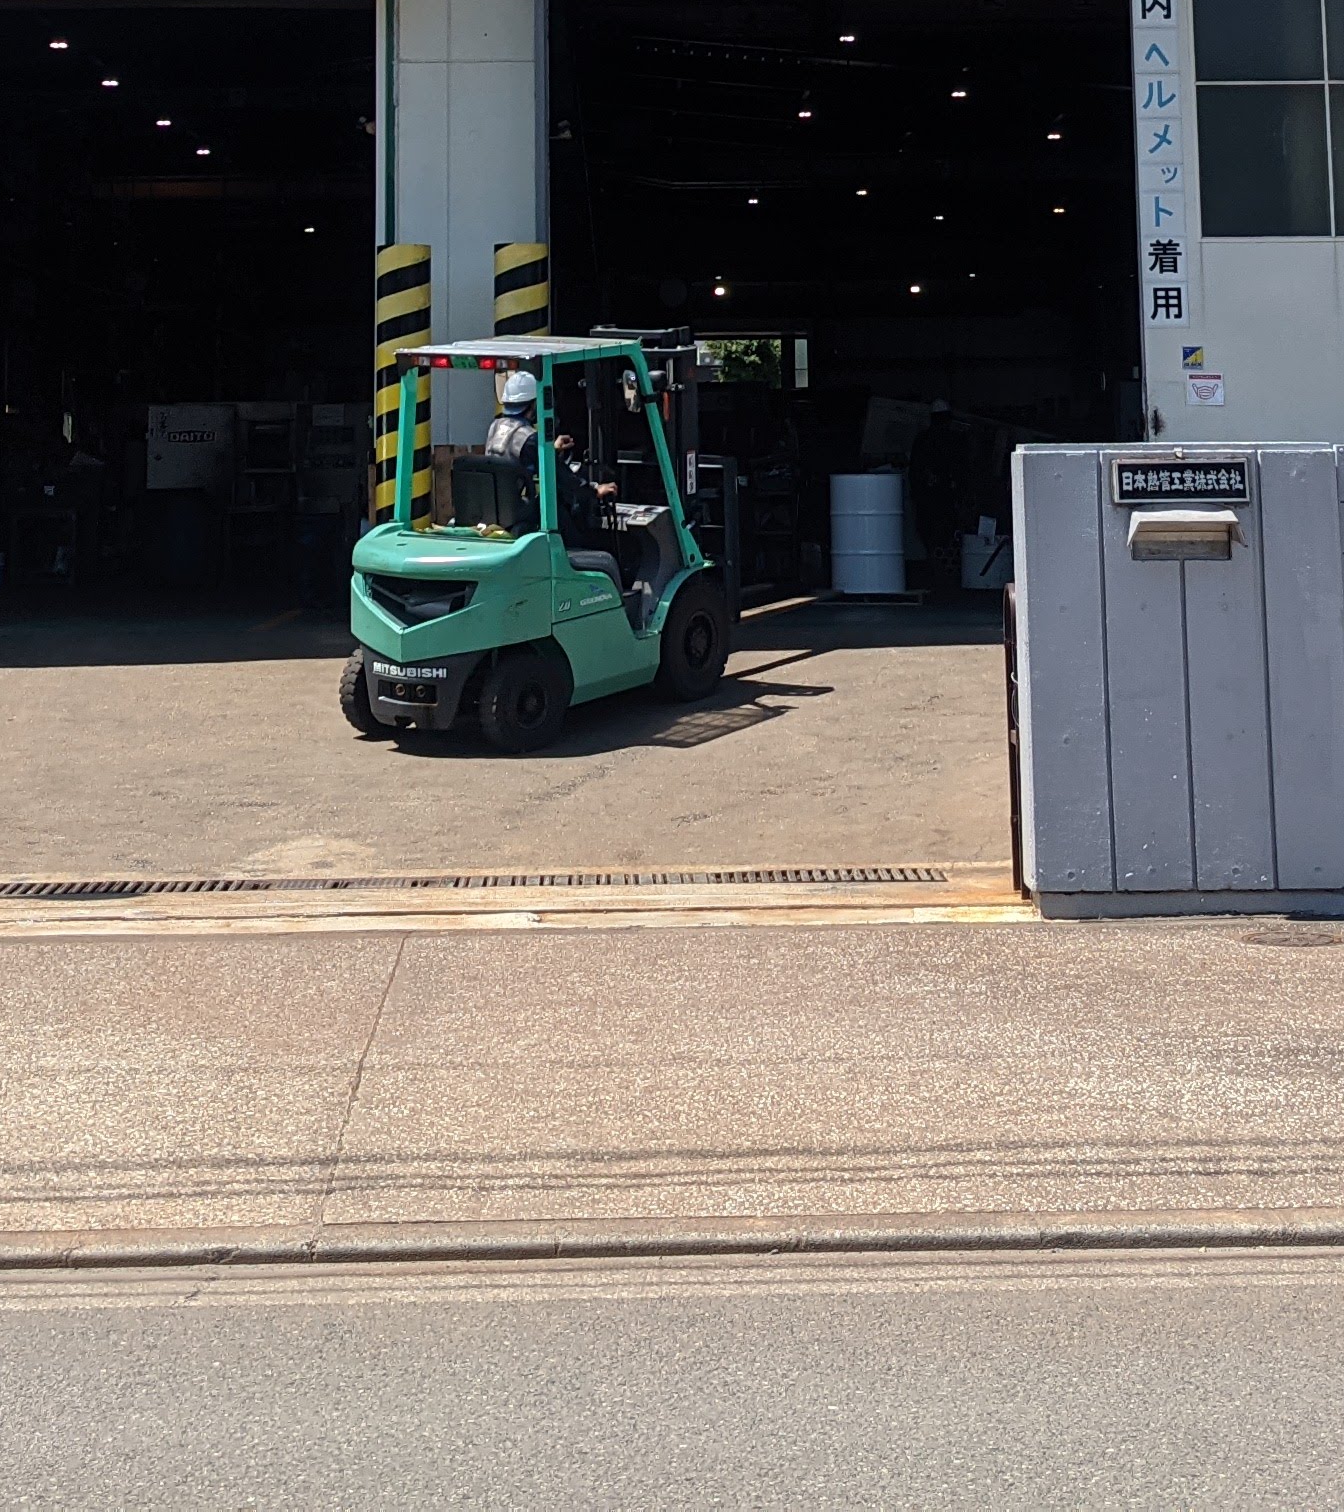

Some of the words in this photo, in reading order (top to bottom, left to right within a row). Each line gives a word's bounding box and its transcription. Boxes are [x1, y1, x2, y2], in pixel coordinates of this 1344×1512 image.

[1121, 468, 1244, 492] 日本熱管工業株式会社
[372, 661, 447, 678] MITSUBISHI
